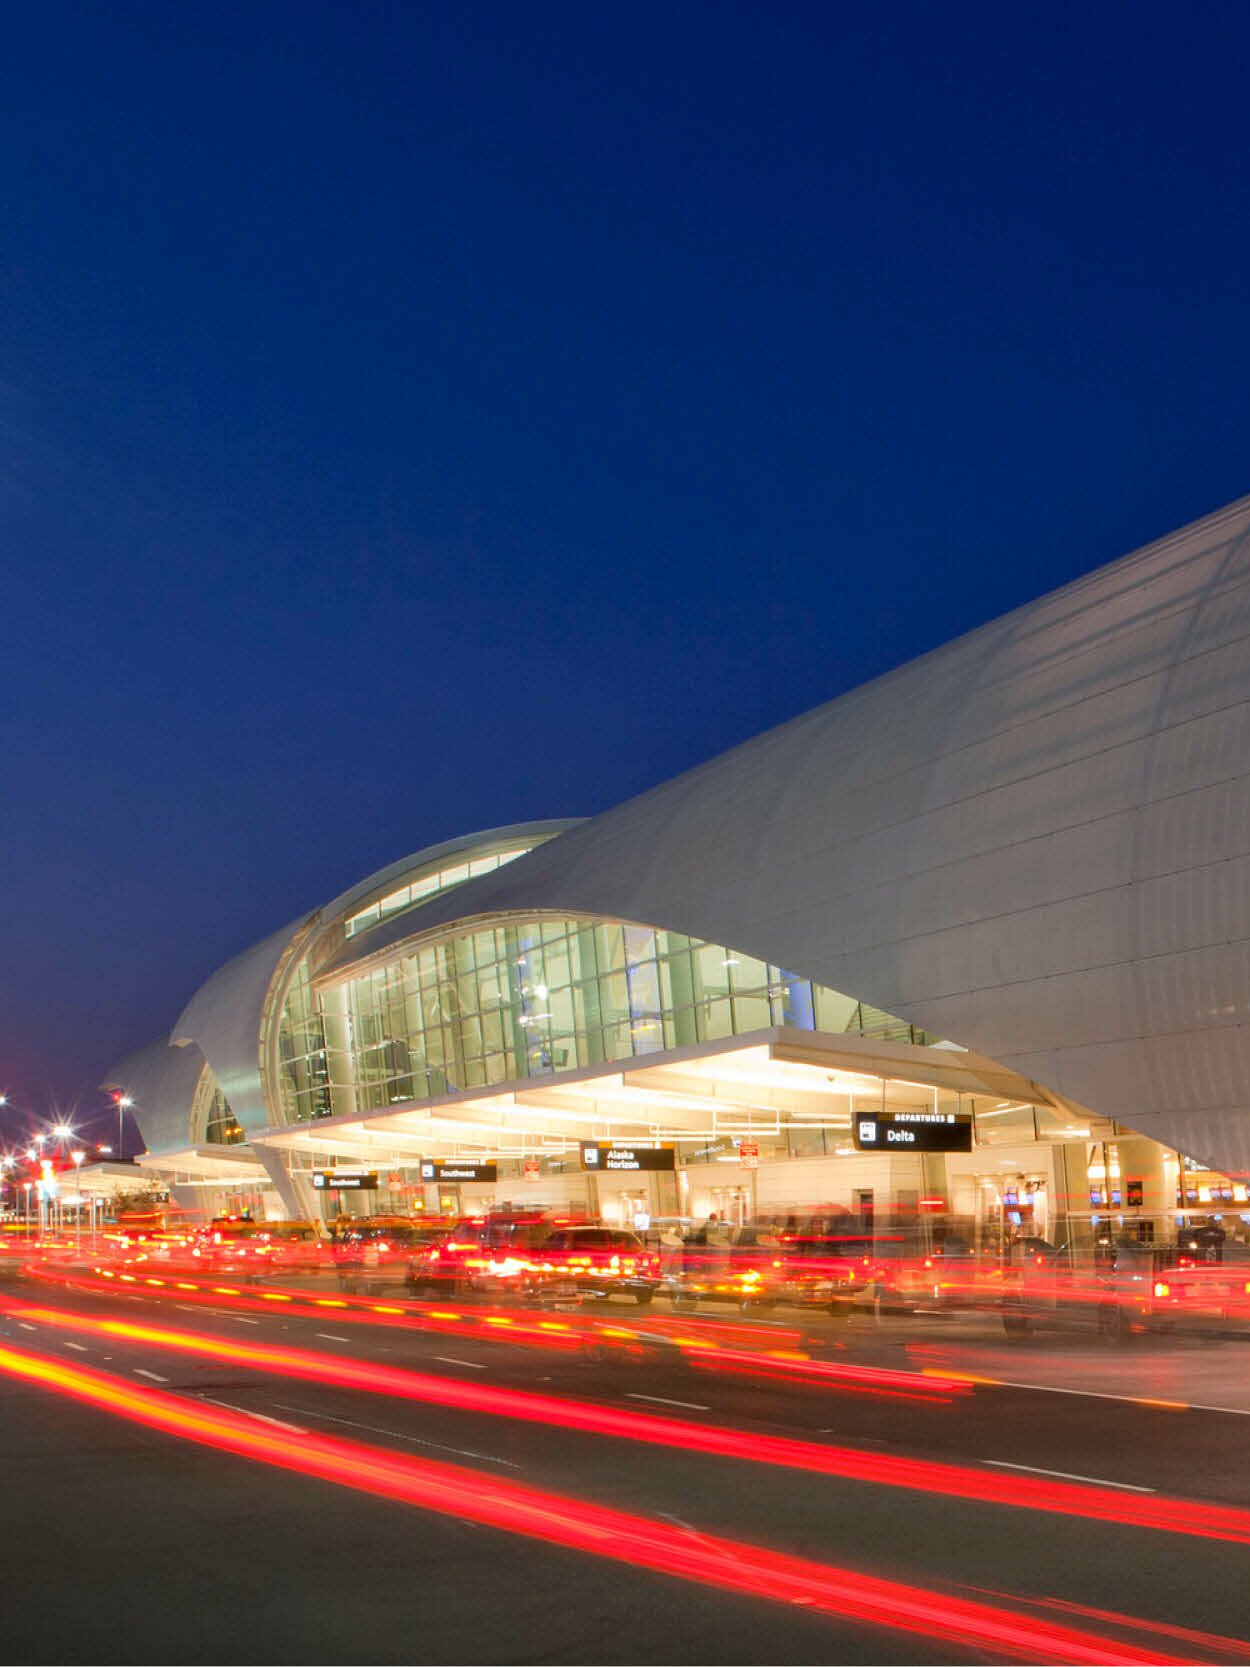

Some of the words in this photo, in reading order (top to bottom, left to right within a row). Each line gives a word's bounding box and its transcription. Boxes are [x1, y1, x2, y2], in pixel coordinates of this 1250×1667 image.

[894, 1113, 946, 1123] DEPARTURES
[887, 1129, 915, 1142] Delta
[607, 1150, 635, 1160] Alaska
[607, 1160, 640, 1169] Horizon
[440, 1169, 476, 1177] Southwest
